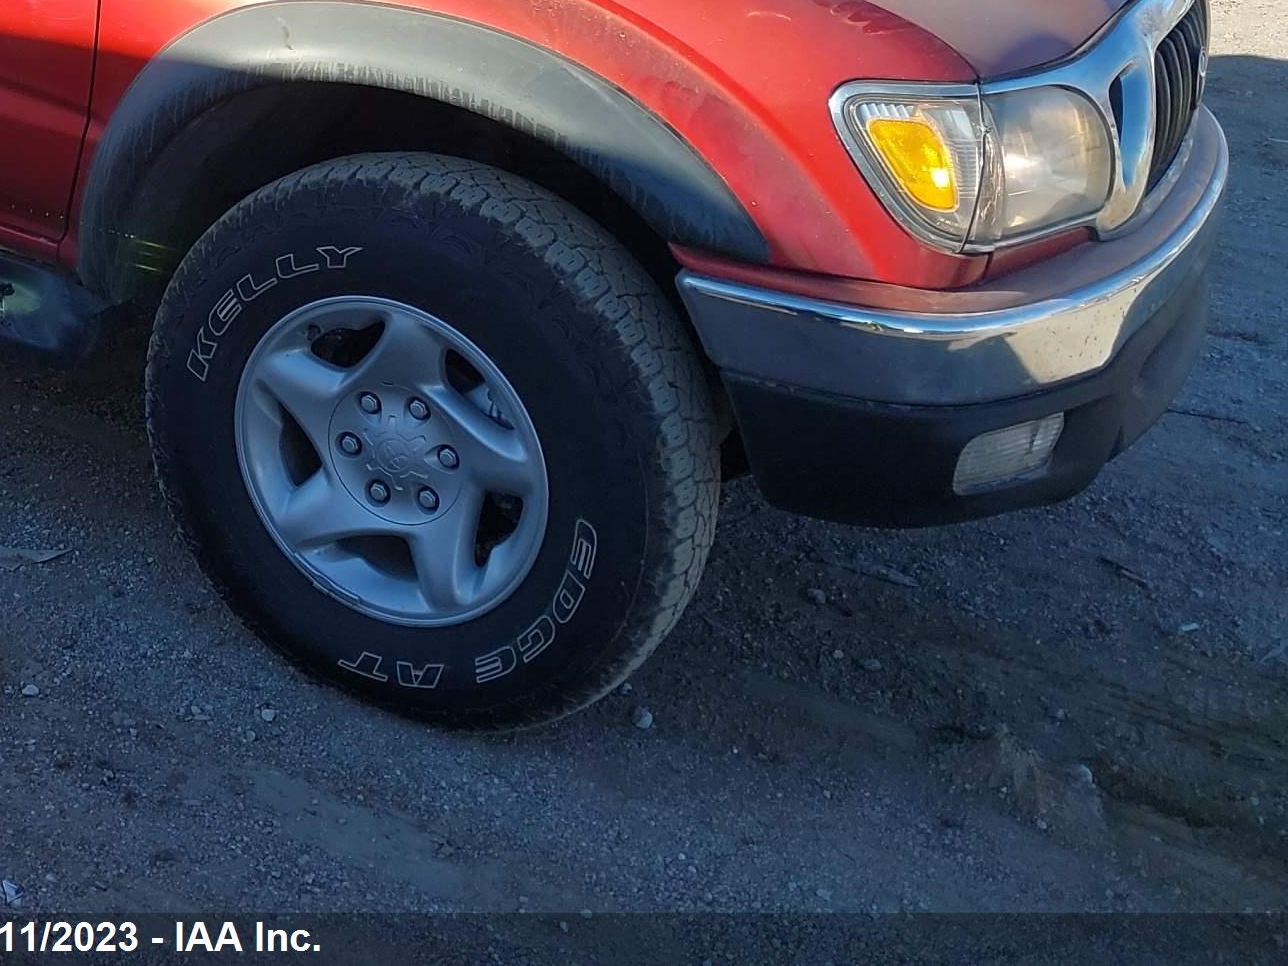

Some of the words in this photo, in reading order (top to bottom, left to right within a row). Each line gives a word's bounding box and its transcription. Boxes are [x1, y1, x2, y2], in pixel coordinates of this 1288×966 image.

[186, 245, 363, 382] KELLY
[337, 650, 445, 689] AT
[474, 518, 598, 684] EDGE
